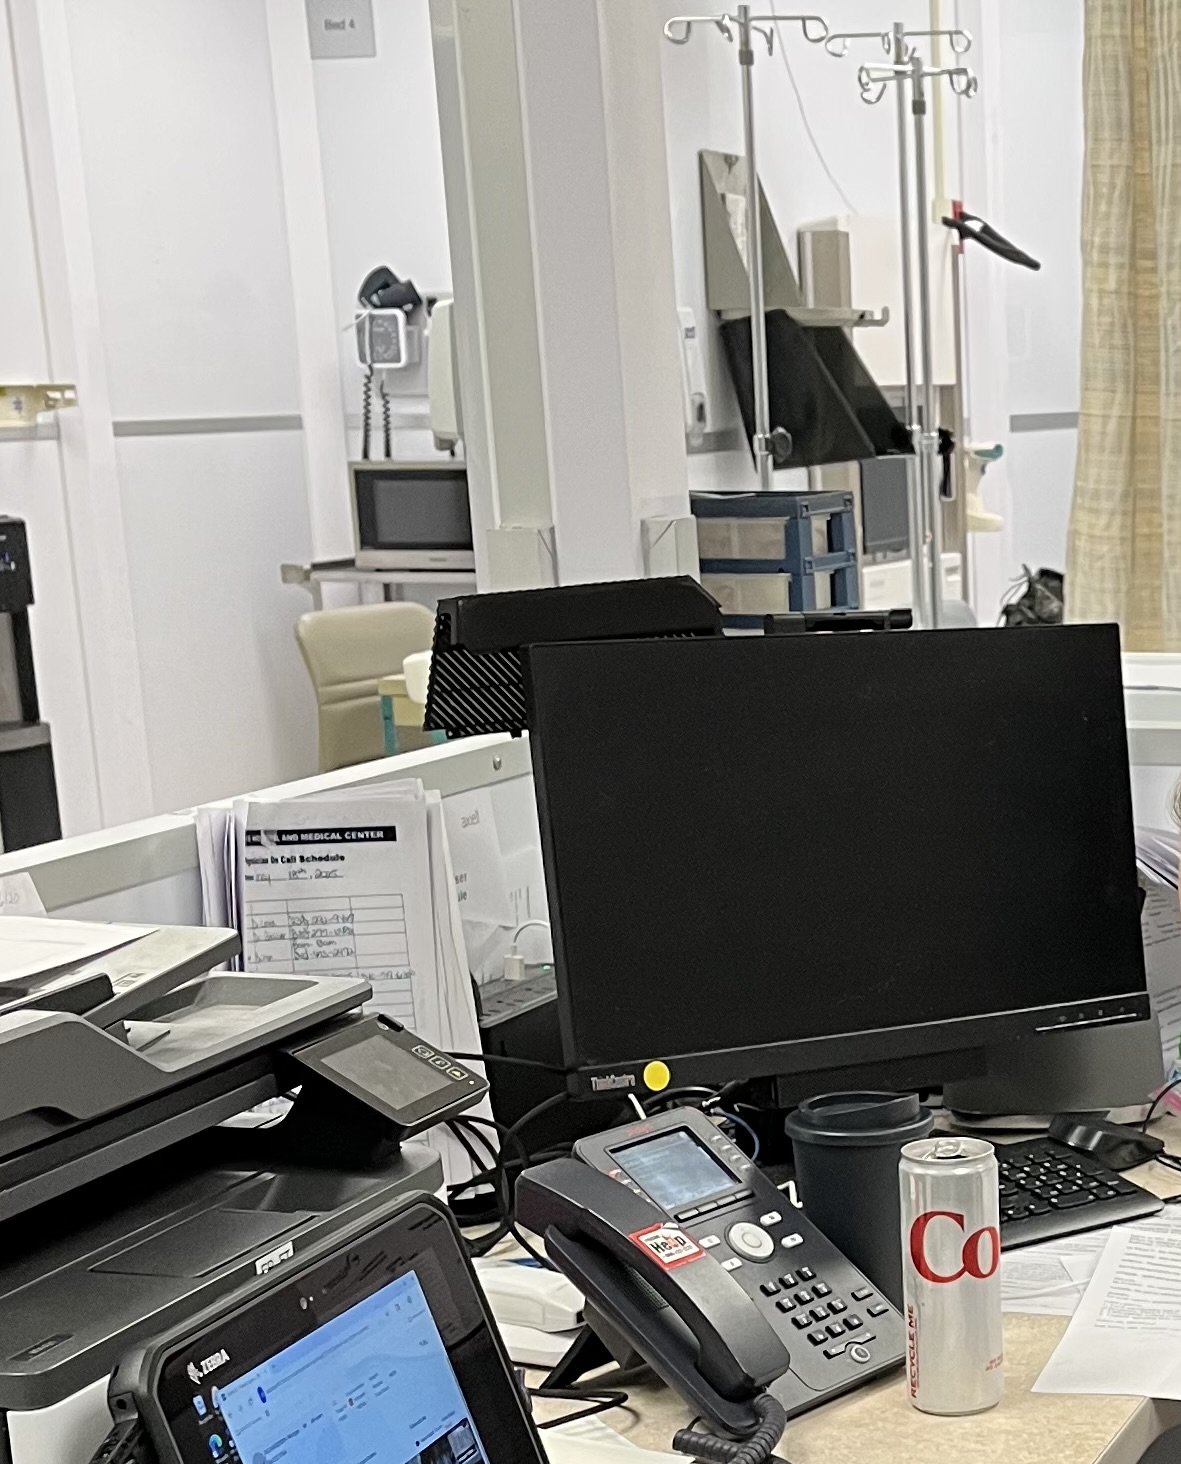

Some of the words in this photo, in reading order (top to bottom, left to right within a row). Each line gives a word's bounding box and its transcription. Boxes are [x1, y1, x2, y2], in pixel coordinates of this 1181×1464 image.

[300, 831, 343, 842] MEDICAL
[344, 830, 385, 840] CENTER
[299, 853, 346, 864] Schedule
[910, 1210, 1000, 1284] Co
[907, 1303, 915, 1329] ME
[908, 1330, 917, 1399] RECYCLE
